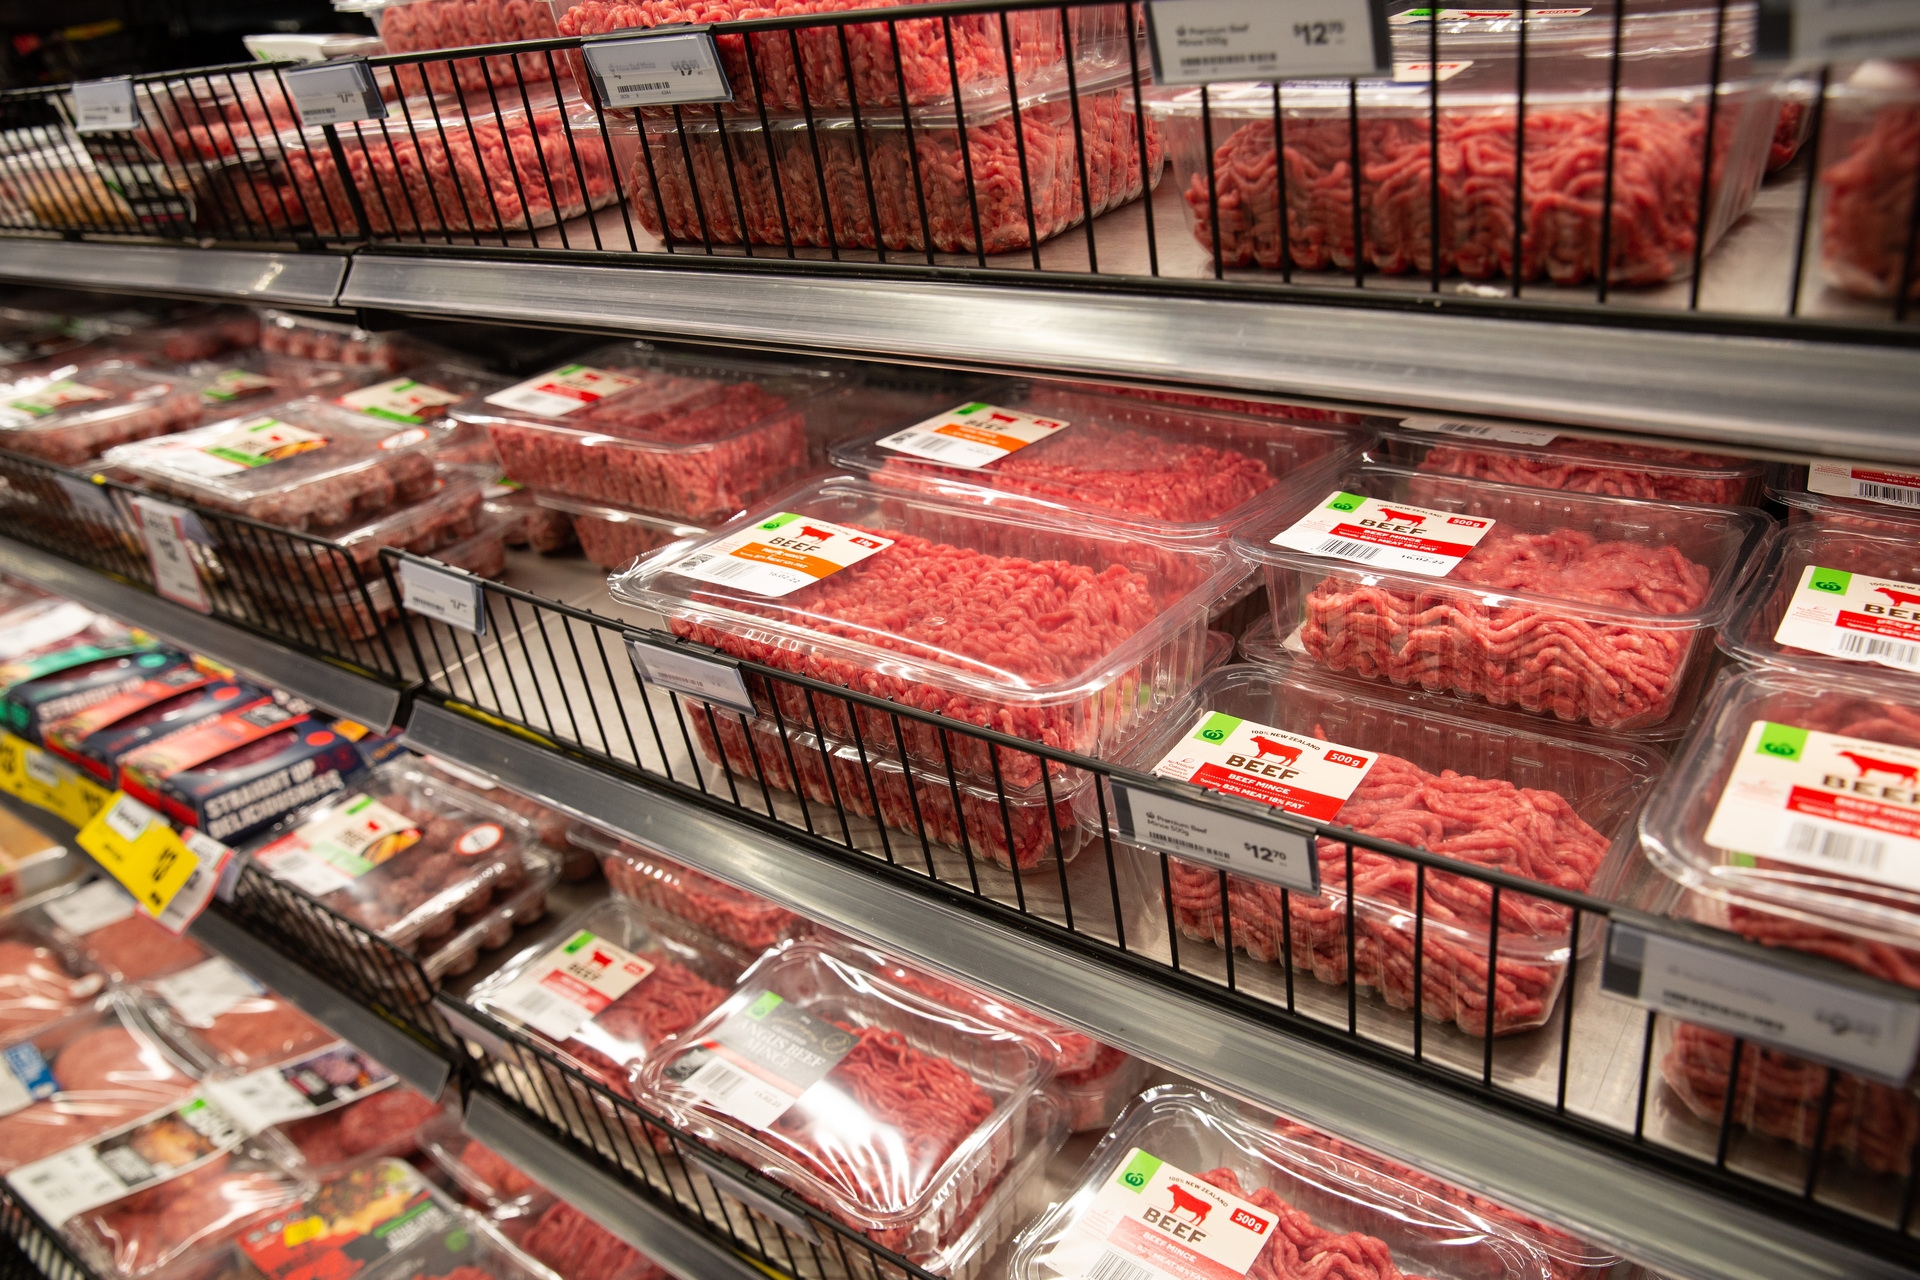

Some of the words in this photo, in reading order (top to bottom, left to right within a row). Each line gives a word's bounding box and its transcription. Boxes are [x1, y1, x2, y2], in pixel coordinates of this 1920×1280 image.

[1412, 508, 1443, 519] ZEALAND
[1452, 518, 1481, 528] 500g
[1359, 518, 1428, 535] BEEF
[1363, 529, 1390, 539] BEEF
[1389, 533, 1423, 543] MINCE
[768, 536, 822, 553] BEEF
[1378, 537, 1404, 546] MEAT
[1420, 544, 1438, 552] FAT
[1270, 731, 1289, 740] NEW
[1288, 736, 1321, 751] ZEALAND
[1225, 754, 1300, 781] BEEF
[1330, 752, 1361, 767] 500g
[204, 766, 292, 815] STRAIGHT
[288, 757, 317, 782] UP
[1200, 777, 1222, 788] Typically
[1222, 782, 1242, 792] 82%
[1240, 787, 1270, 800] MEAT
[1268, 795, 1286, 805] 18%
[1285, 800, 1305, 810] FAT
[1228, 772, 1257, 787] BEEF
[1255, 780, 1291, 795] MINCE
[206, 768, 346, 840] DELICIOUSNESS
[1147, 819, 1170, 831] Mince
[1170, 825, 1190, 837] 500g
[1156, 815, 1190, 830] Premium
[1190, 825, 1208, 834] Beef
[743, 1036, 796, 1070] MINCE
[786, 1041, 827, 1070] BEEF
[1168, 1176, 1185, 1184] 100%
[1185, 1179, 1201, 1190] NEW
[1200, 1186, 1229, 1208] ZEALAND
[1142, 1206, 1207, 1244] BEEF
[1235, 1211, 1264, 1232] 500g
[1142, 1231, 1167, 1247] BEEF
[1165, 1242, 1197, 1263] MINCE
[1152, 1251, 1176, 1270] MEAT
[1189, 1268, 1208, 1280] FAT
